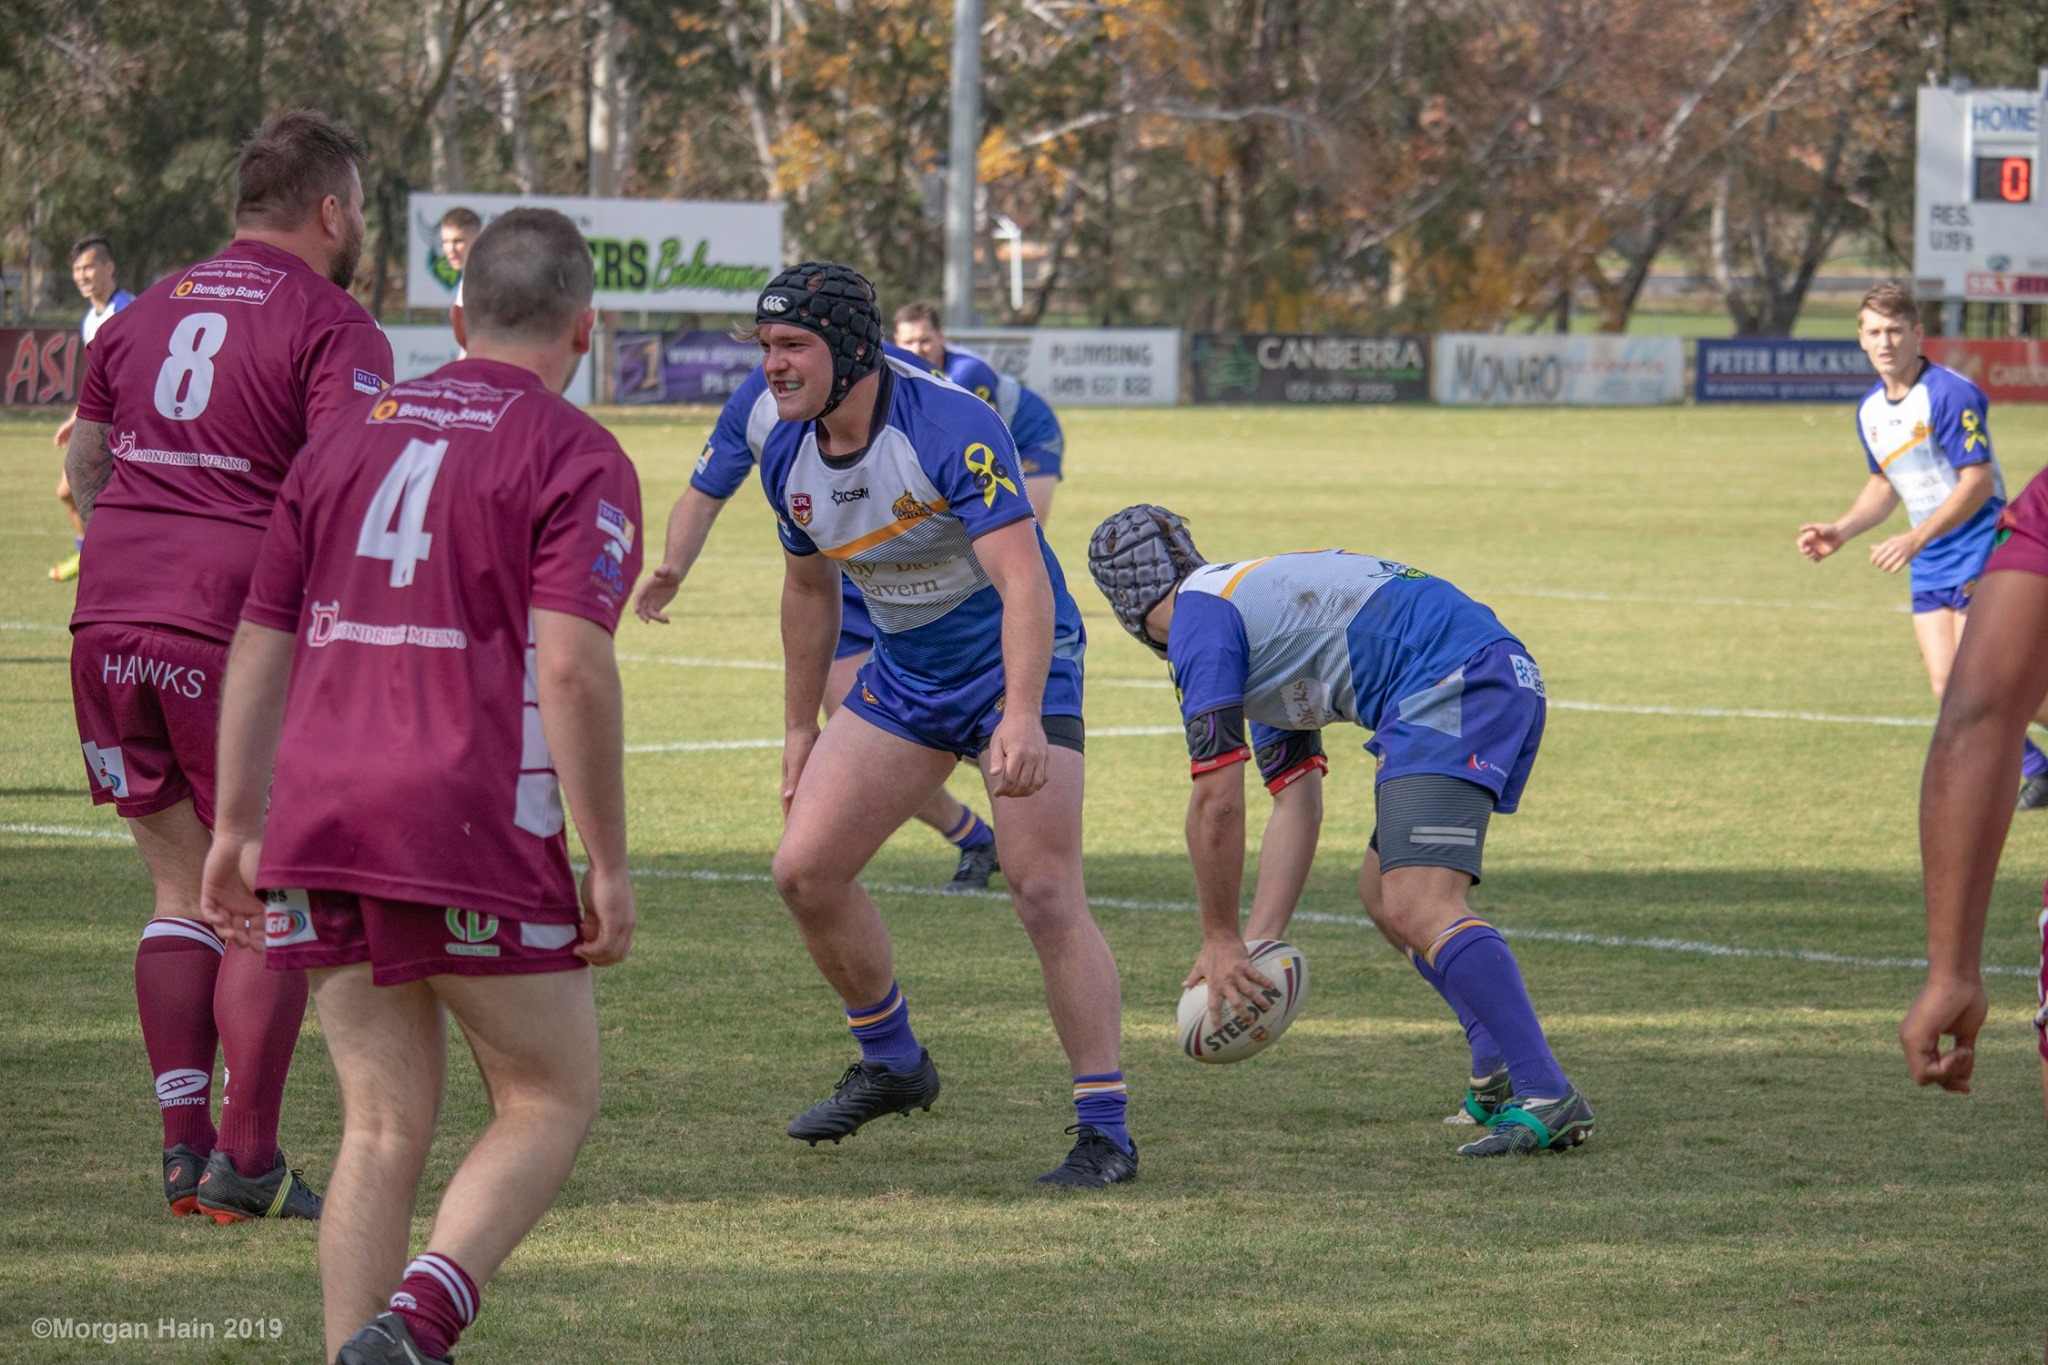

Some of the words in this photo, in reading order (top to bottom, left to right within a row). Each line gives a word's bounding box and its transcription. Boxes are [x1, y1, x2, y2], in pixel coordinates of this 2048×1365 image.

[1973, 106, 2036, 131] HOME
[2002, 157, 2029, 202] 0
[192, 283, 235, 297] Bendigo
[235, 286, 267, 300] Bank
[154, 312, 228, 420] 8
[1053, 341, 1152, 369] PLUMBING
[1257, 337, 1425, 370] CANBERRA
[1706, 349, 1770, 374] PETER
[1455, 344, 1563, 400] MONARO
[200, 454, 251, 472] MERINO
[792, 497, 810, 507] CRL
[844, 488, 870, 502] CSM
[356, 438, 449, 588] 4
[103, 654, 207, 699] HAWKS
